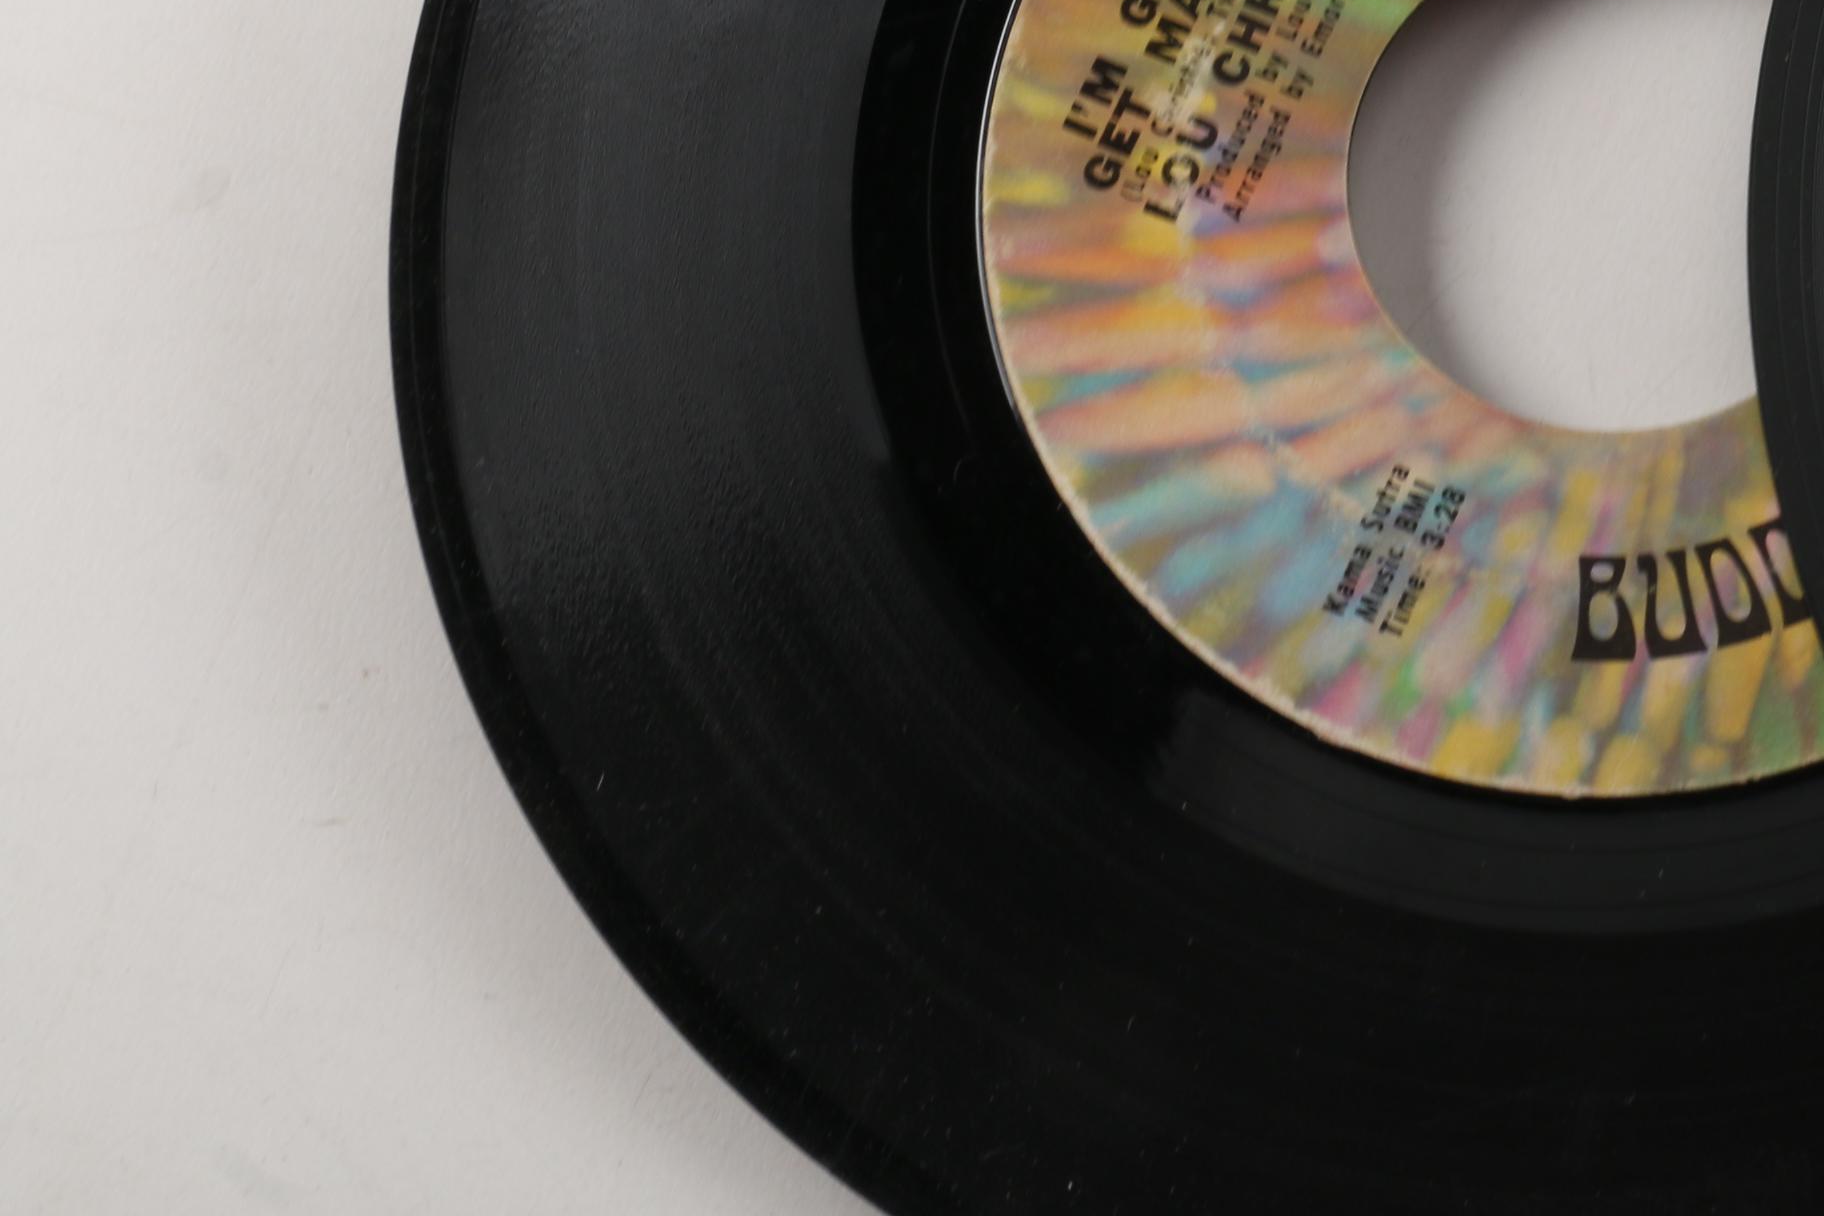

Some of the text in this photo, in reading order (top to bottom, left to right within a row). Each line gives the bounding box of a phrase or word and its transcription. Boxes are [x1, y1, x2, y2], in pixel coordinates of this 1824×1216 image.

[1062, 56, 1129, 141] I'M
[1083, 89, 1151, 190] GET
[1143, 112, 1218, 222] LOU
[1196, 89, 1265, 205] Produced
[1255, 51, 1288, 83] by
[1222, 105, 1291, 222] Arranged
[1280, 67, 1314, 99] by
[1321, 464, 1410, 616] Kama Sutra
[1354, 479, 1435, 624] Music BMI
